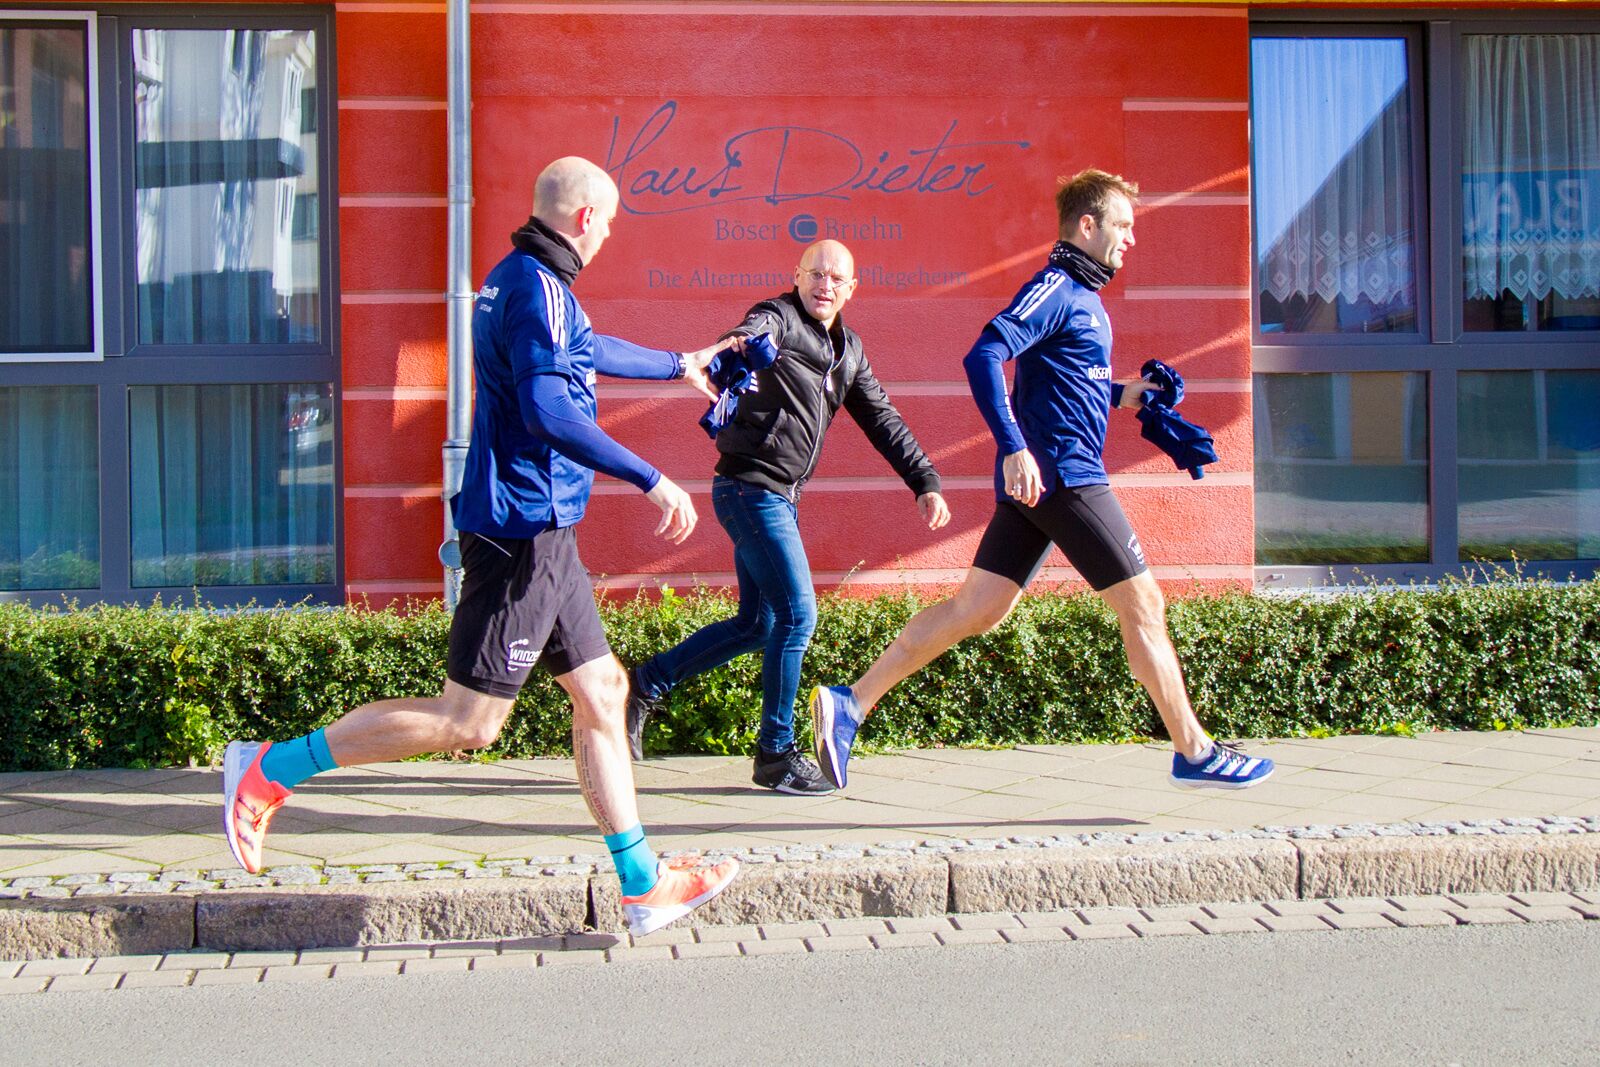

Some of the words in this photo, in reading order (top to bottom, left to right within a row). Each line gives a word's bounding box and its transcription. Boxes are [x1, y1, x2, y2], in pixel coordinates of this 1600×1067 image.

[604, 100, 743, 214] Haus
[724, 119, 1030, 205] Dieter
[714, 218, 781, 241] Böser
[824, 216, 903, 241] Briehn
[648, 269, 683, 288] Die
[857, 264, 970, 292] Pflegeheim
